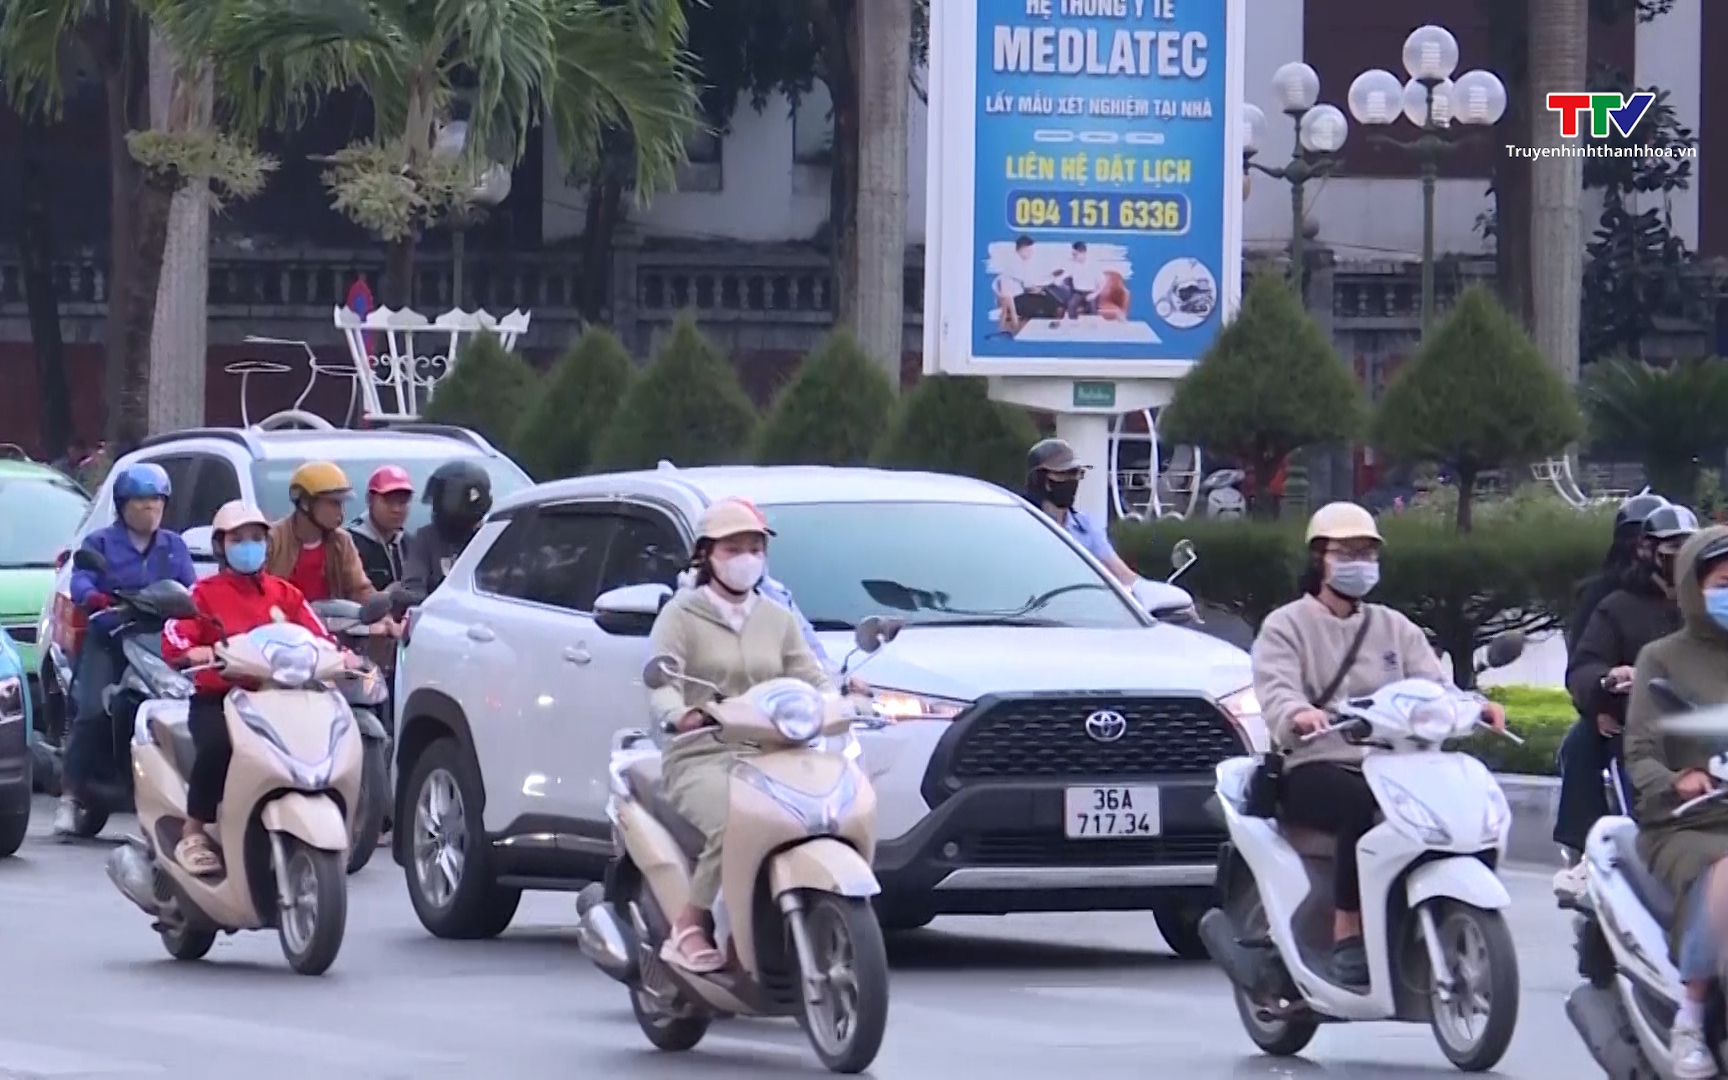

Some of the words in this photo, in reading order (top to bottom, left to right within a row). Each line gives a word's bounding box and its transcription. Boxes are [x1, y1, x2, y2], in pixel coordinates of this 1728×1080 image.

[993, 25, 1208, 78] MEDLATEC
[1154, 99, 1177, 120] TẠI
[1006, 151, 1055, 180] LIÊN
[1061, 152, 1088, 186] HỆ
[1143, 159, 1192, 188] LỊCH
[1015, 197, 1061, 225] 094
[1069, 199, 1109, 226] 151
[1119, 200, 1179, 228] 6336
[1093, 789, 1133, 810] 36A
[1077, 813, 1150, 834] 717.34
